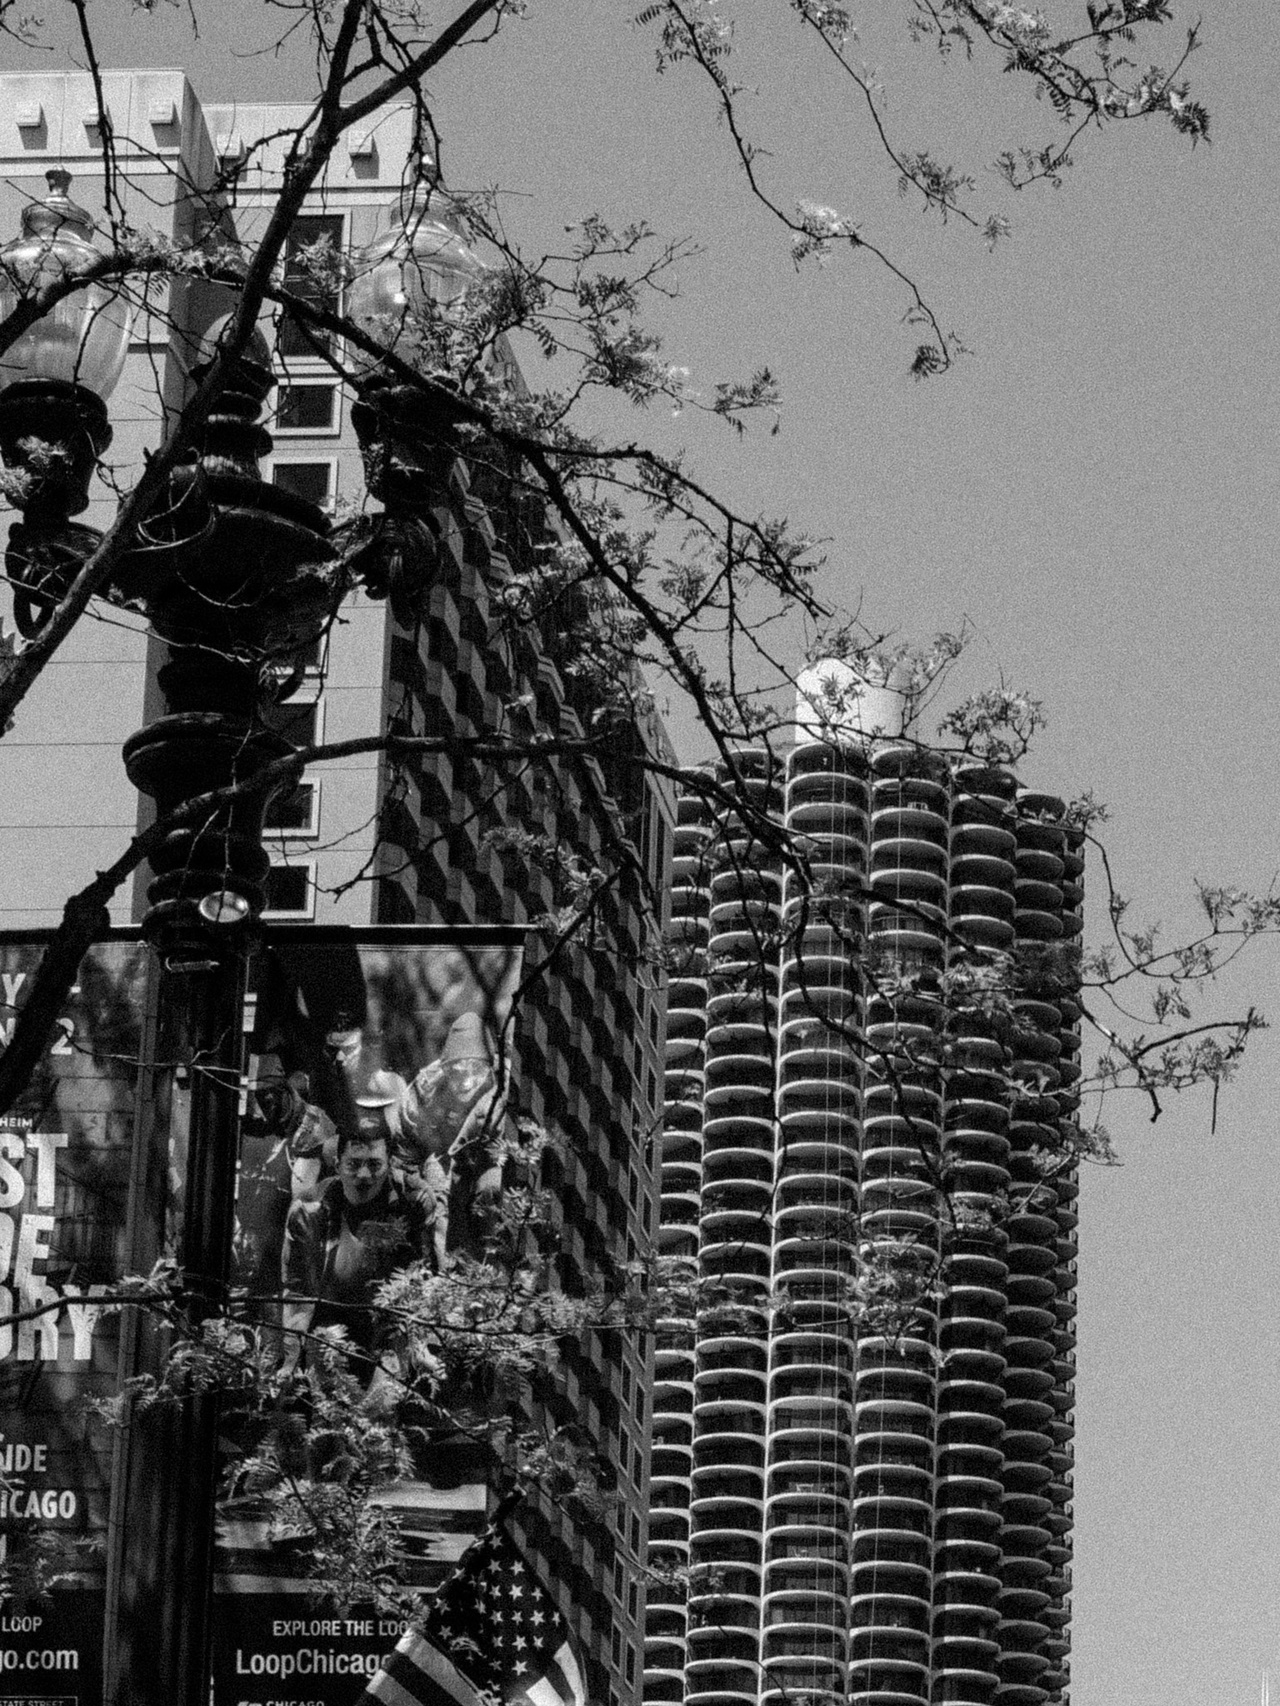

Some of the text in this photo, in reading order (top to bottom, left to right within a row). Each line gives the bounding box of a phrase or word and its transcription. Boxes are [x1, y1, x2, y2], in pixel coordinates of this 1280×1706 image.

[1, 1616, 43, 1632] LOOP
[272, 1620, 410, 1637] EXPLORE THE LOO
[236, 1649, 391, 1679] LoopChicag
